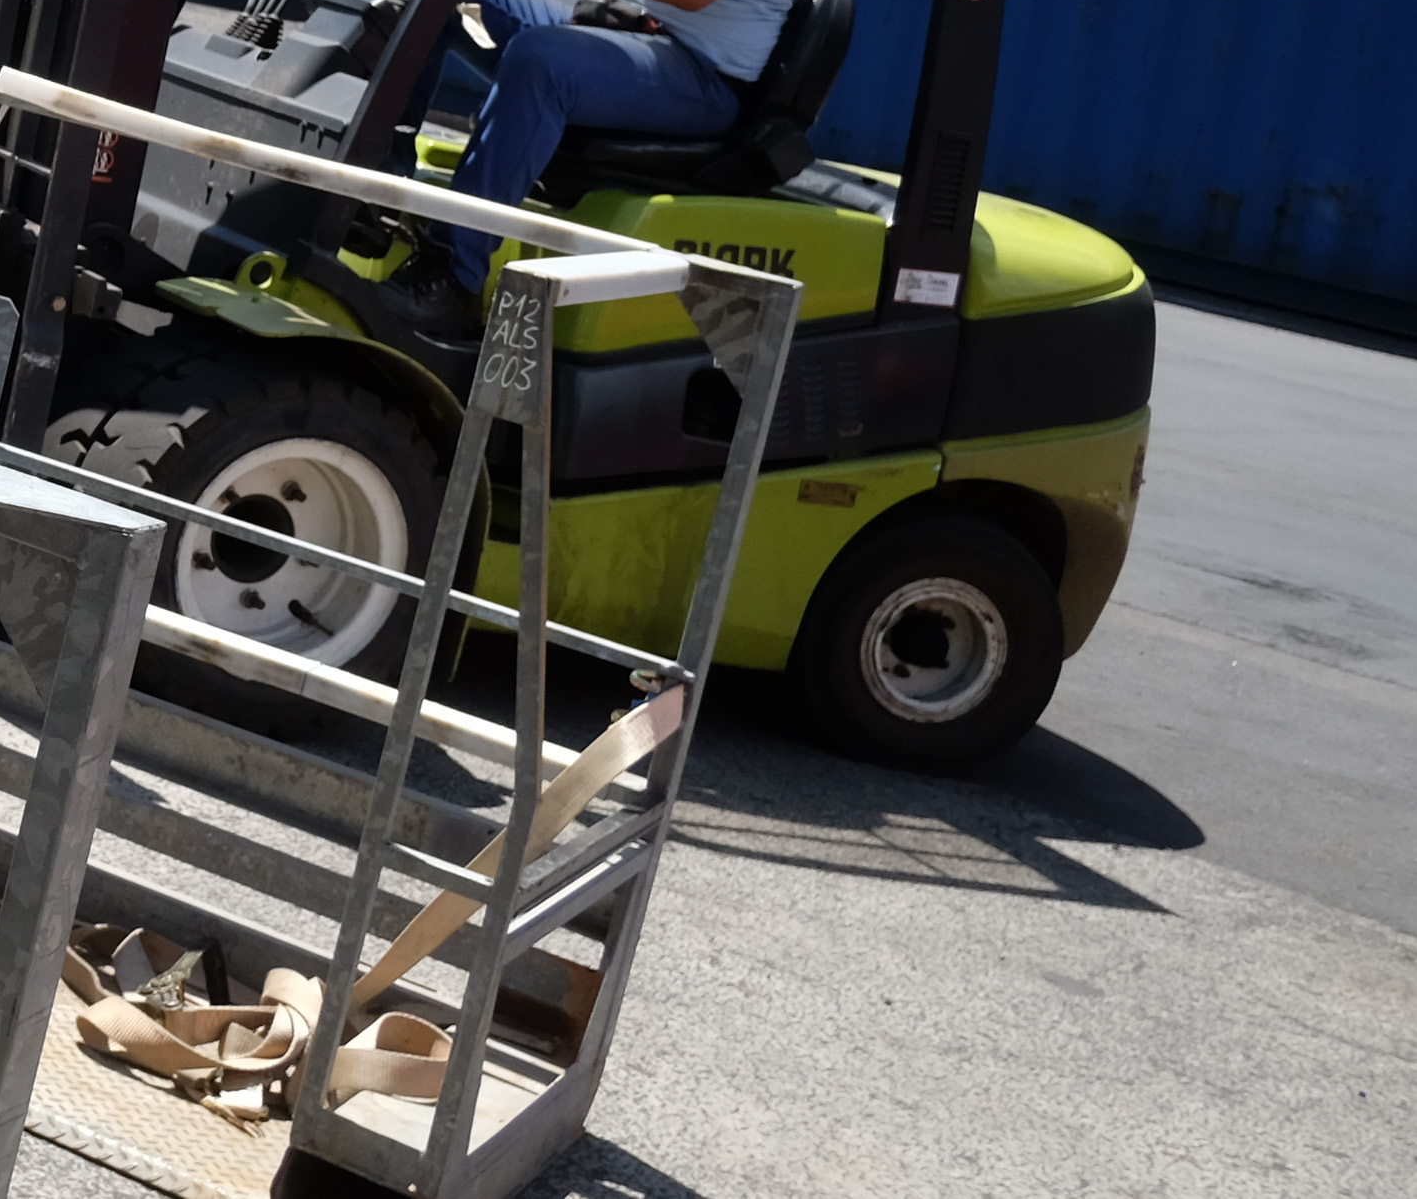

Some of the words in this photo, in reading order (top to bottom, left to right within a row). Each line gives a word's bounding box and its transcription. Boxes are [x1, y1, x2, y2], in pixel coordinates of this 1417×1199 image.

[498, 290, 541, 323] P12
[491, 319, 540, 350] ALS
[483, 353, 538, 391] 003
